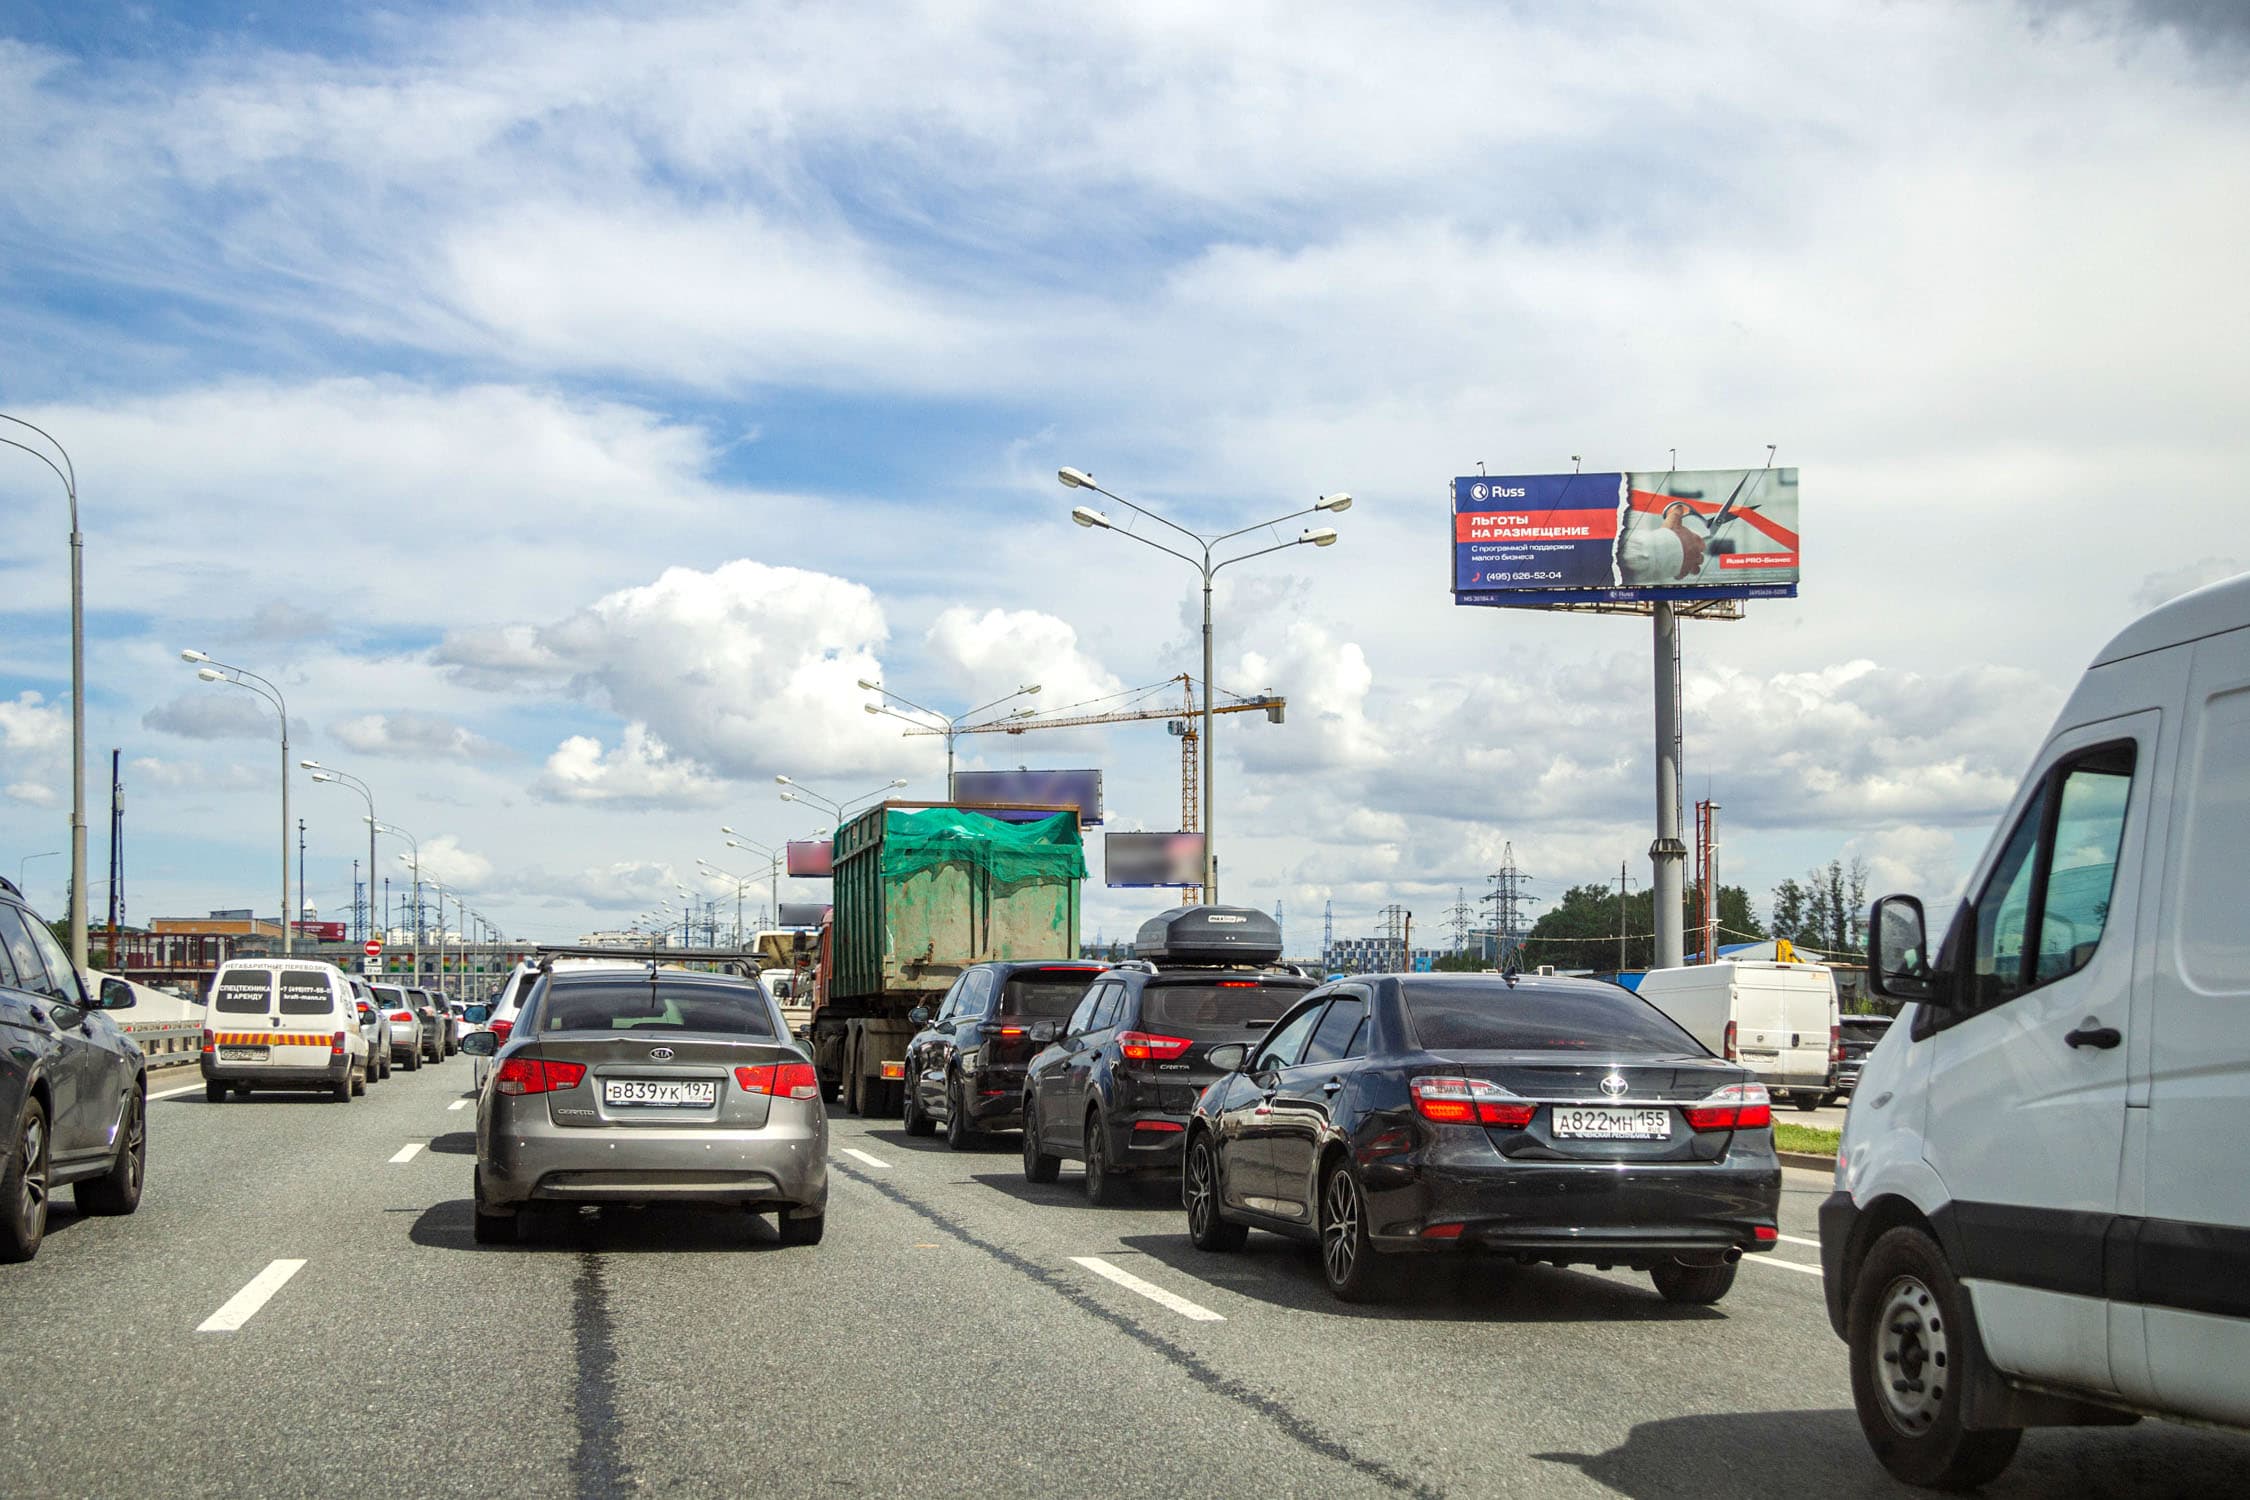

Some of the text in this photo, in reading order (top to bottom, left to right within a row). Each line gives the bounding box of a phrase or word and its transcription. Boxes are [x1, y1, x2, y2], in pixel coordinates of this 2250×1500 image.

[1492, 486, 1525, 497] Russ
[1471, 516, 1529, 530] ЛЬГОТЫ
[1471, 527, 1590, 538] НА РАЗМЕЩЕНИЕ
[1479, 544, 1528, 553] программой
[1529, 544, 1575, 552] поддержки
[1486, 571, 1562, 581] (495) 626-52-04
[220, 984, 272, 992] СПЕЦТЕХНИКА
[233, 993, 263, 1001] АРЕНДУ
[652, 1050, 670, 1058] KIA
[613, 1083, 679, 1100] В839УК
[684, 1084, 709, 1096] 197
[1560, 1112, 1664, 1131] А822МН 155
